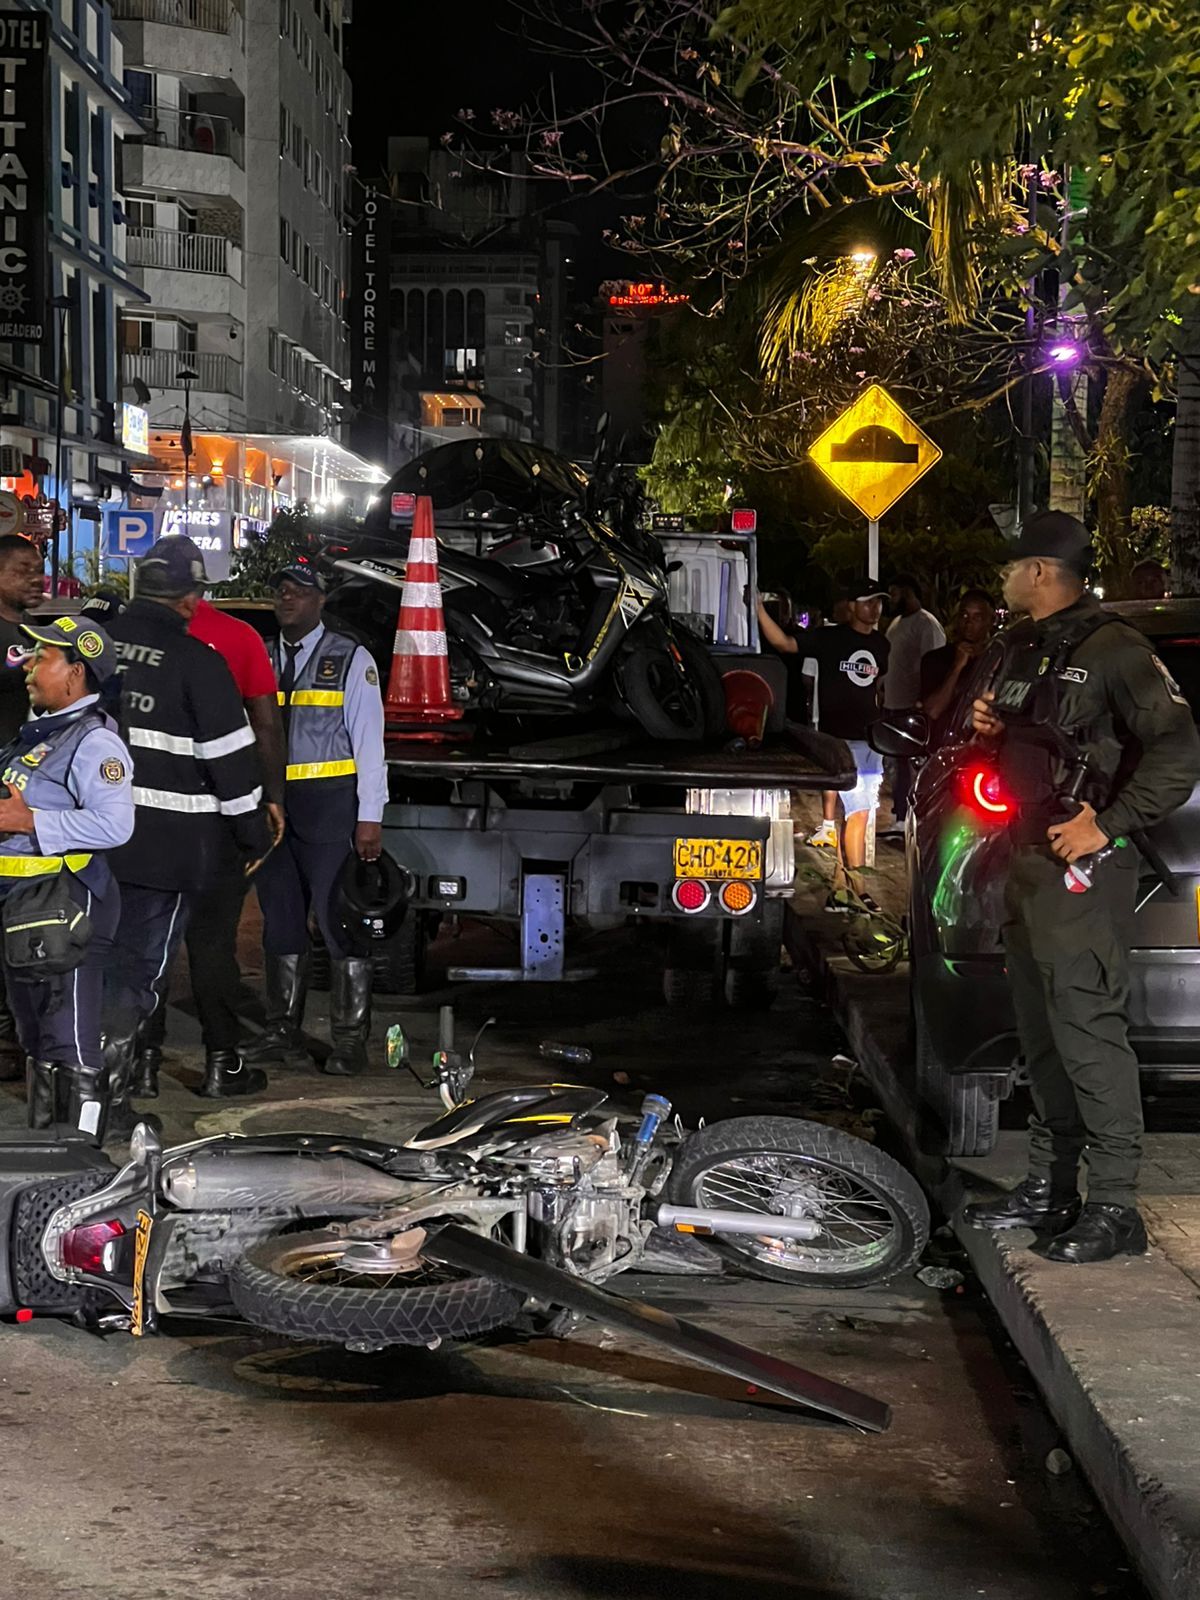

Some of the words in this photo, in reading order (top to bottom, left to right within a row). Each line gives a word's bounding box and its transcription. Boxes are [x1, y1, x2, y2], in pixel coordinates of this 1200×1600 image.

[0, 57, 28, 274] TITANIC
[364, 185, 377, 263] HOTEL
[0, 322, 43, 339] UEADERO
[363, 272, 376, 350] TORRE
[362, 359, 376, 390] MA
[118, 516, 148, 551] P
